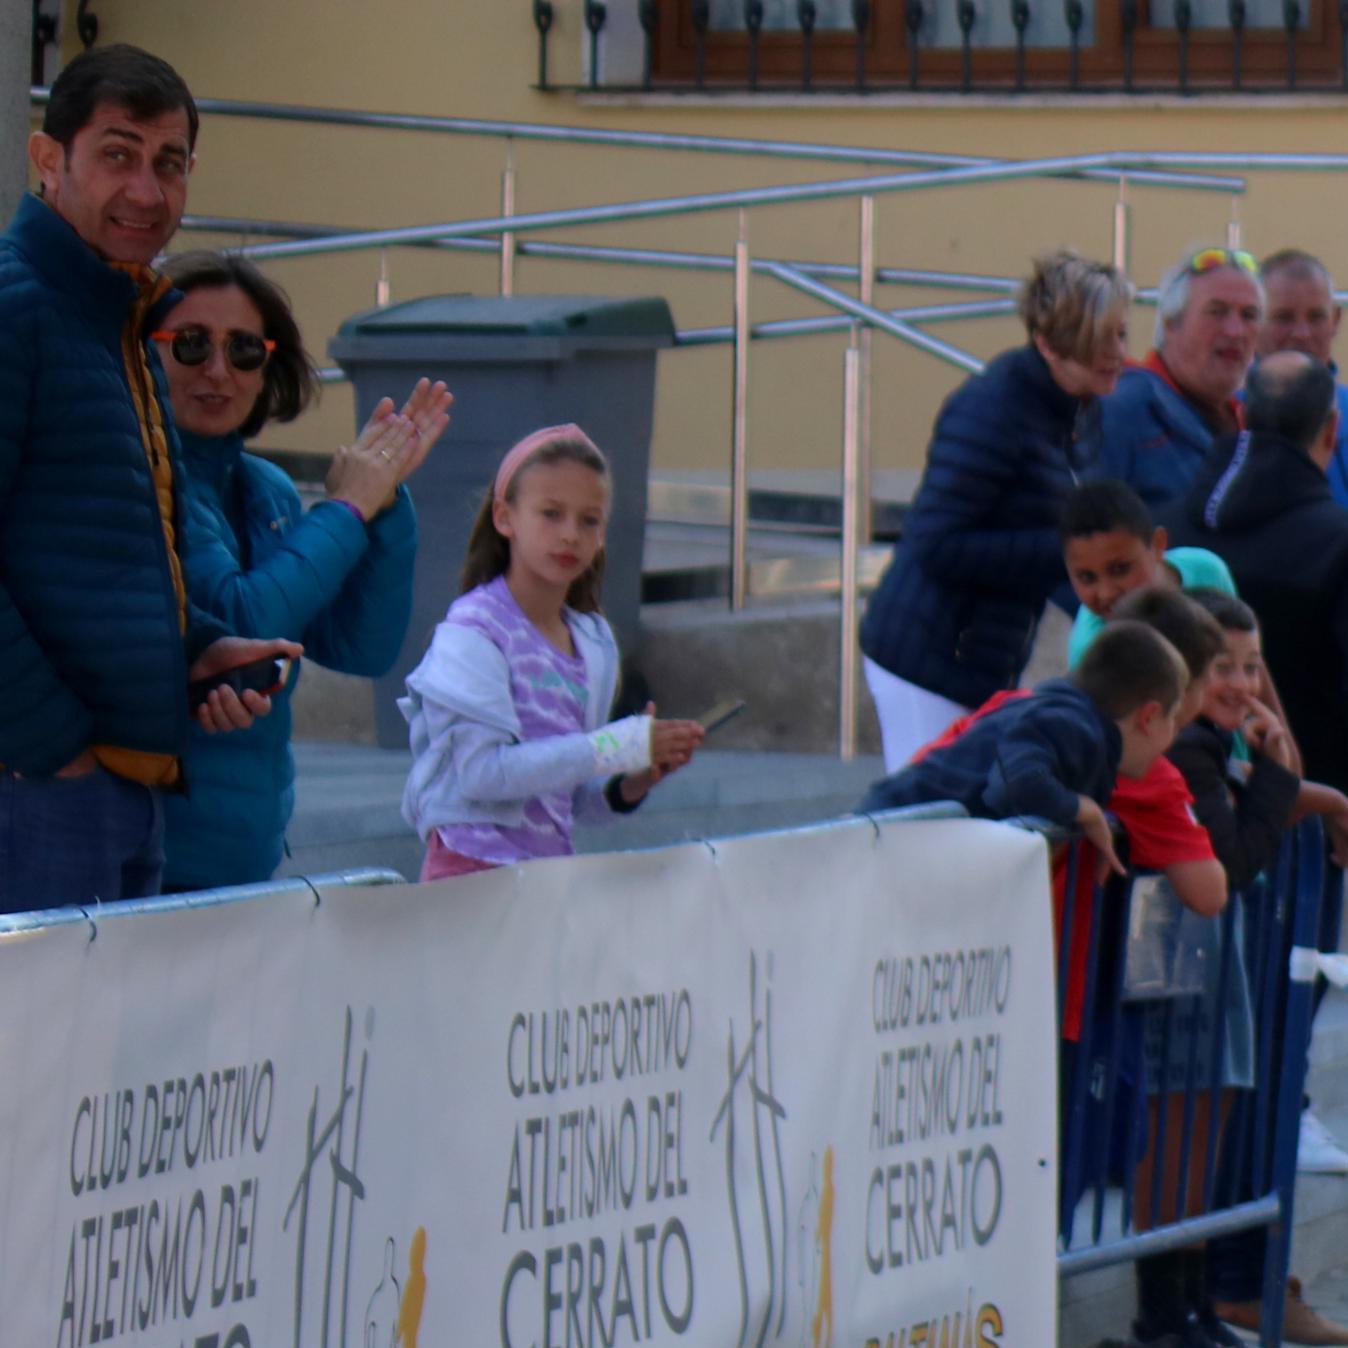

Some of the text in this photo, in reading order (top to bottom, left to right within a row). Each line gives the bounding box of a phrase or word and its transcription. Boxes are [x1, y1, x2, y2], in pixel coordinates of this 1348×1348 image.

[507, 989, 692, 1098] CLUB DEPORTIVO
[872, 945, 1011, 1034] CLUB DEPORTIVO
[70, 1059, 274, 1197] CLUB DEPORTIVO
[869, 1033, 1003, 1152] ATLETISMO DEL
[502, 1090, 688, 1233] ATLETISMO DEL
[865, 1143, 1003, 1275] CERRATO
[211, 1177, 258, 1308] DEL
